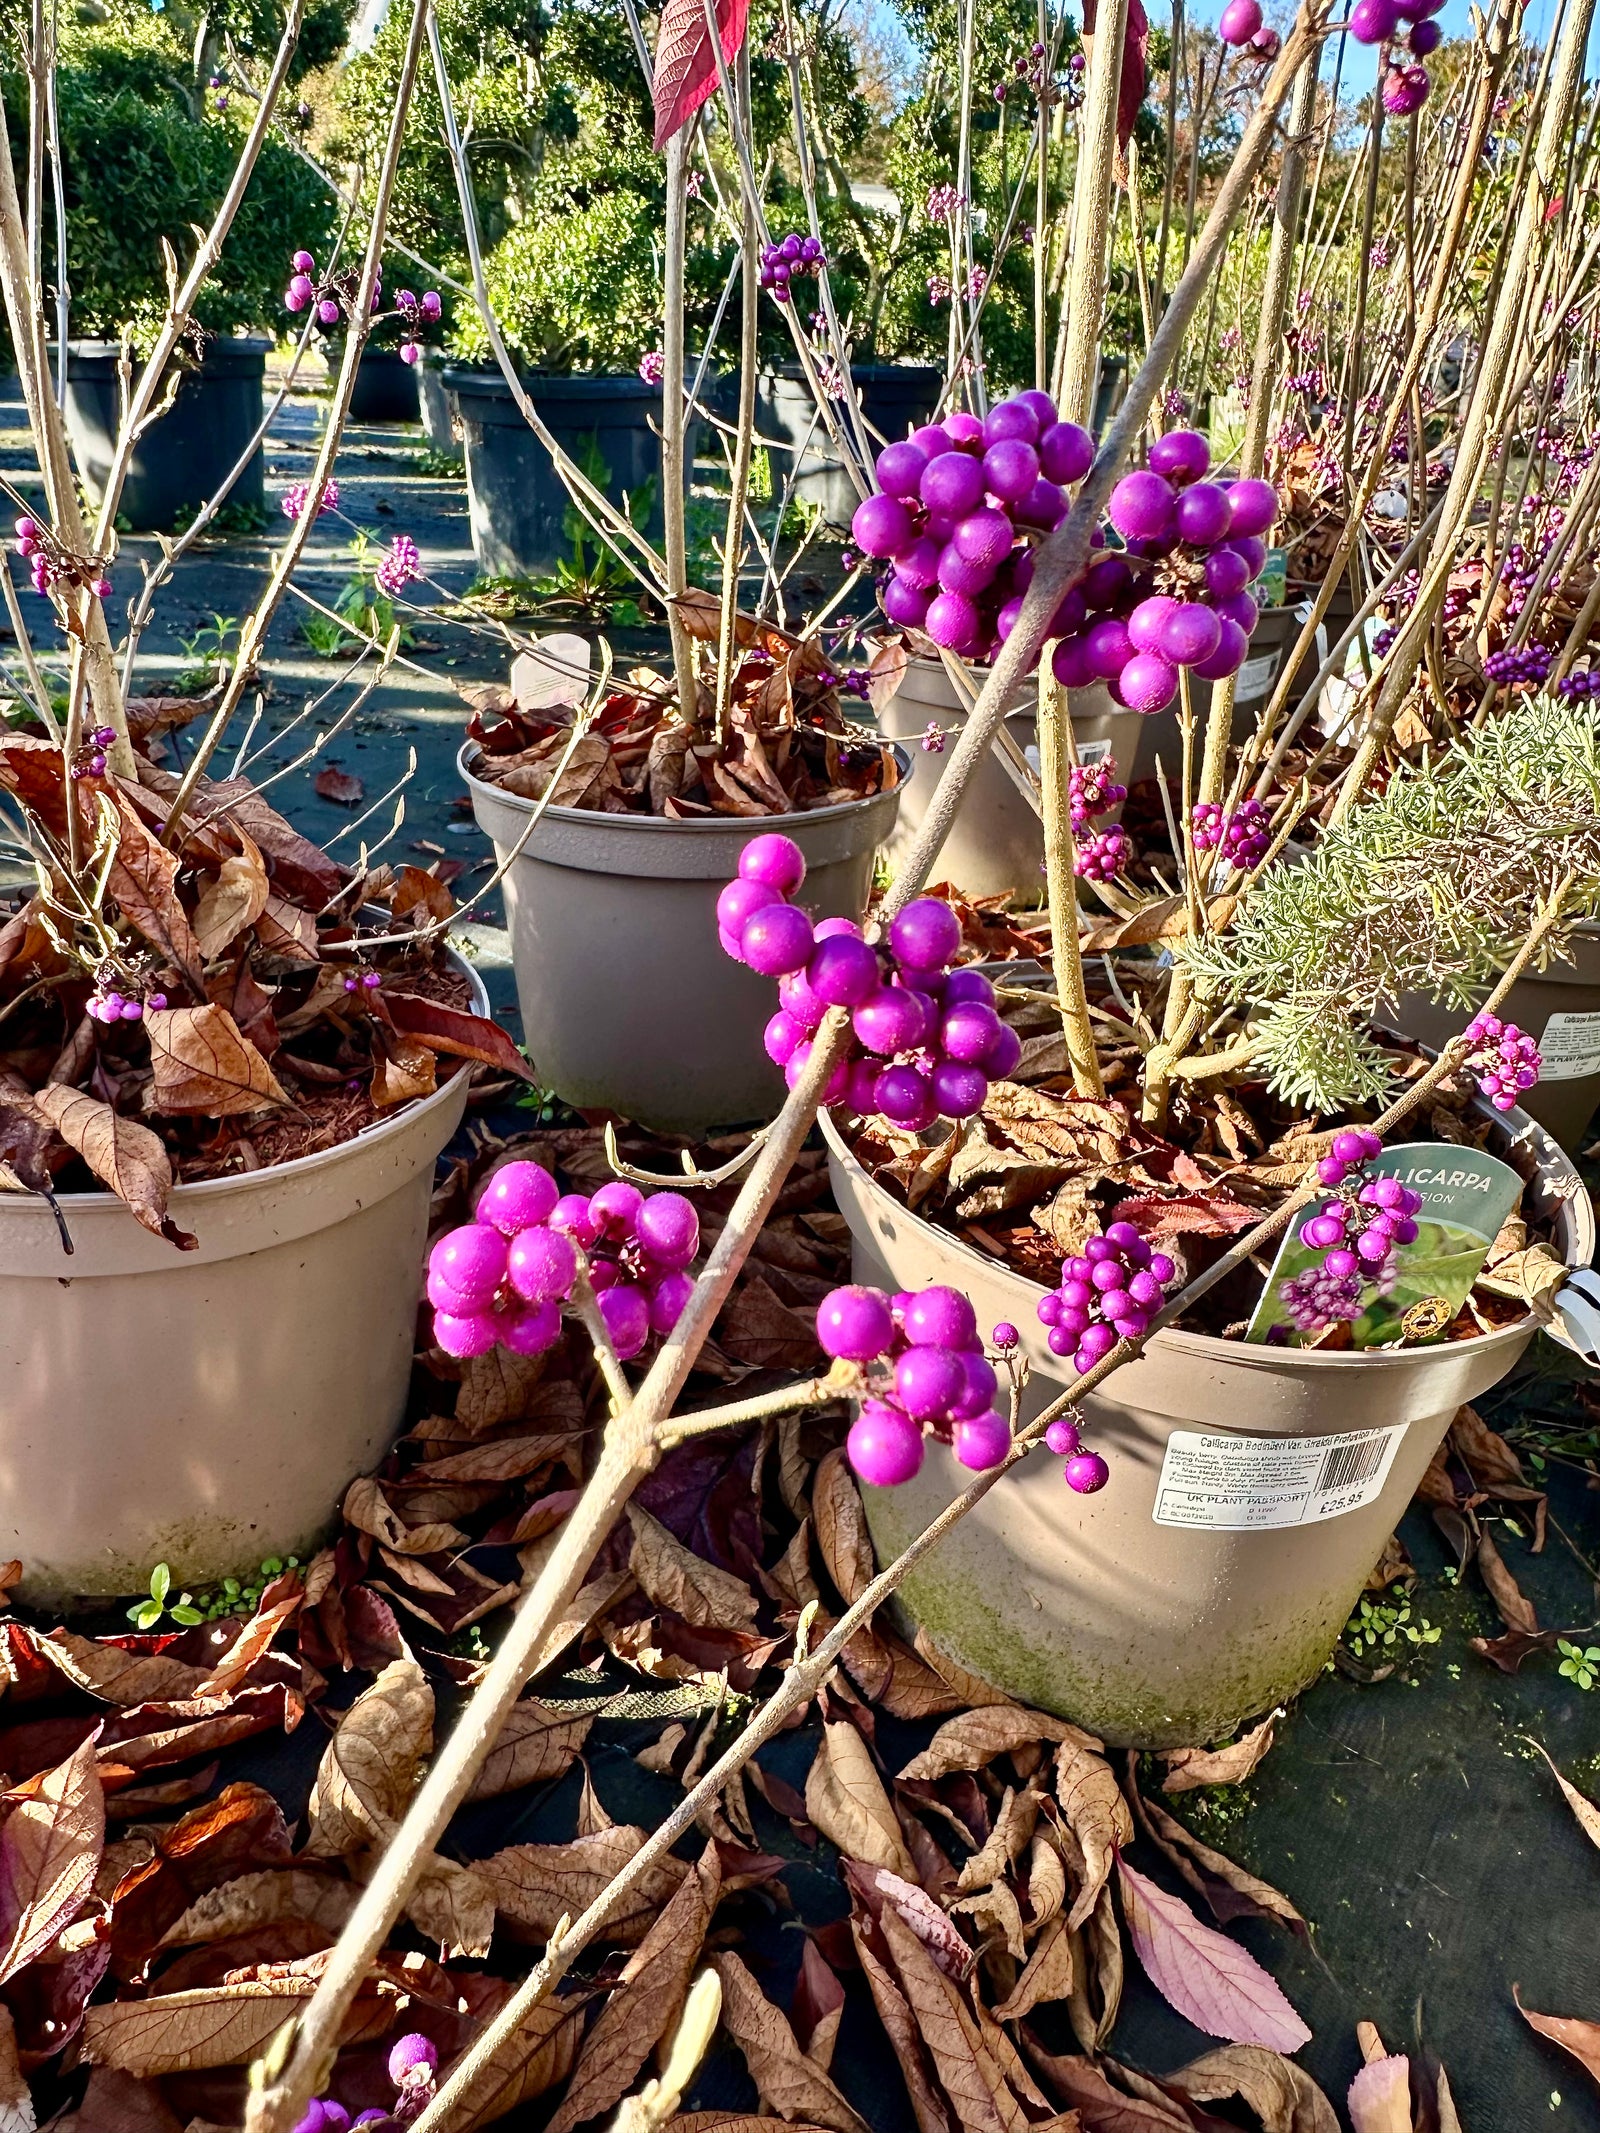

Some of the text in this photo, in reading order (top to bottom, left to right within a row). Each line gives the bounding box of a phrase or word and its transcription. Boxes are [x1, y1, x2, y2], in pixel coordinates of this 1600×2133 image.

[1200, 1437, 1243, 1452] Callicarpa
[1287, 1440, 1302, 1450] Var.
[1334, 1430, 1370, 1445] Profusion
[1187, 1493, 1305, 1504] UK PLANT PASSPORT
[1320, 1490, 1364, 1514] £25.95
